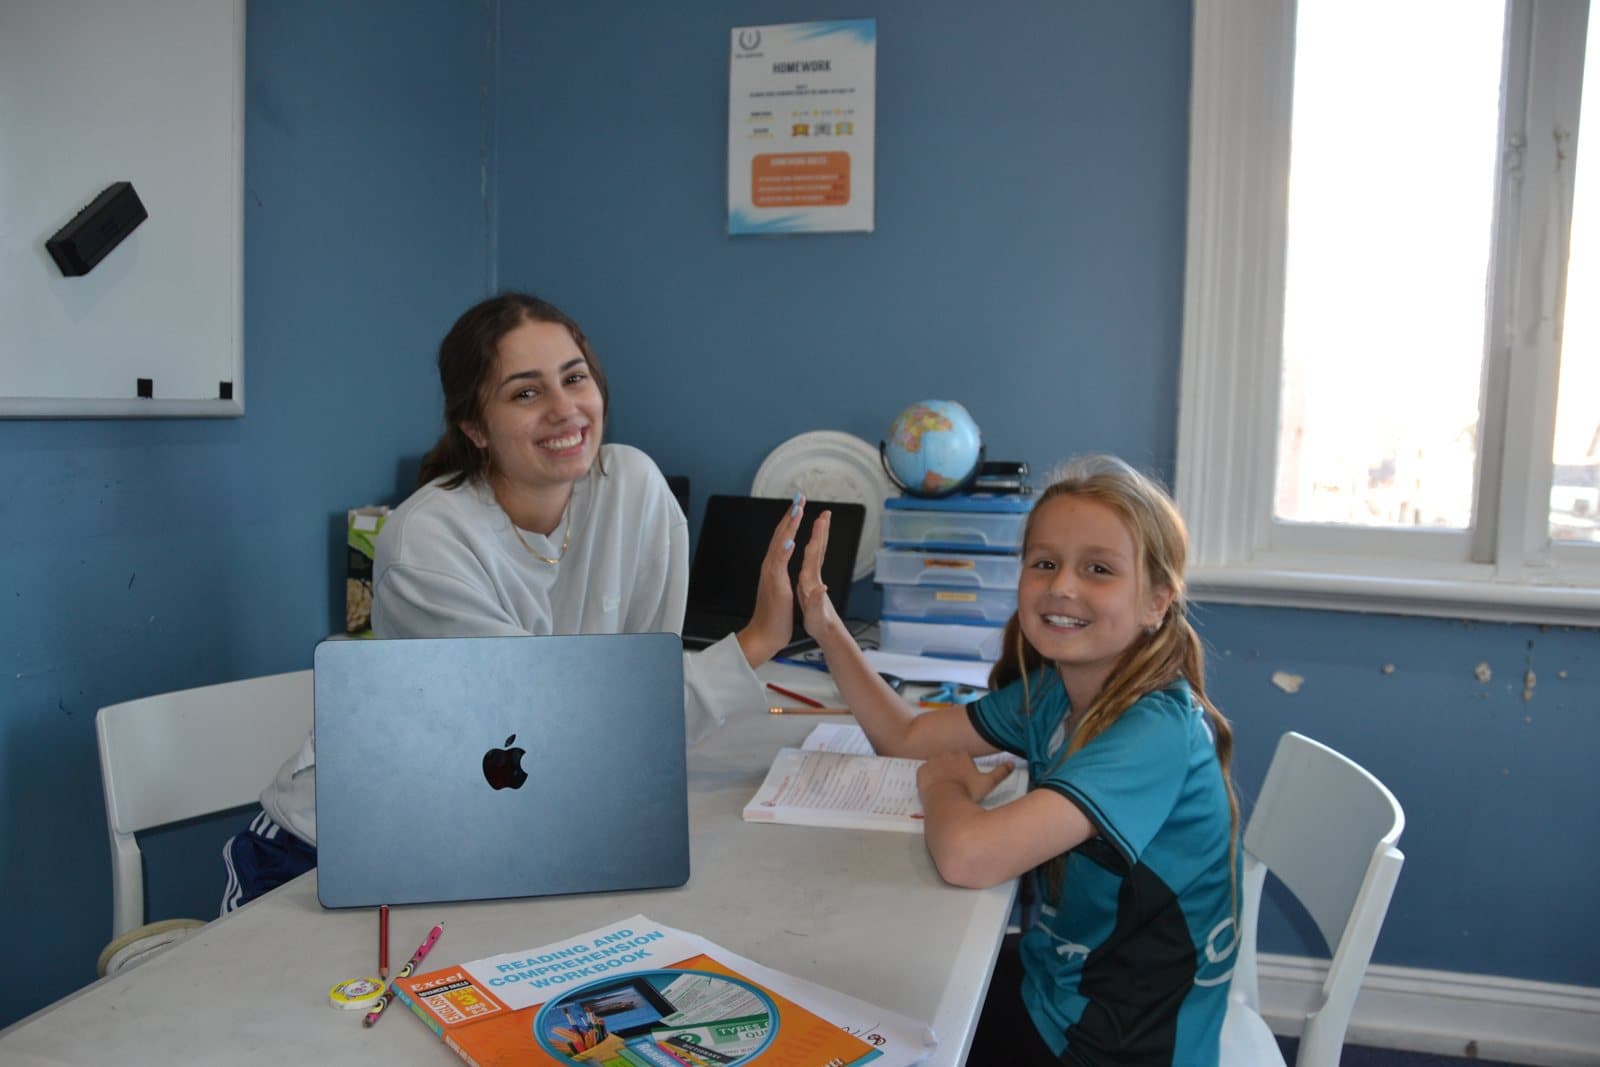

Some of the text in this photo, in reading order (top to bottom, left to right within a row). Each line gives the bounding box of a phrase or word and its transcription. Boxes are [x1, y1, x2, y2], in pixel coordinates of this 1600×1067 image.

[772, 60, 832, 73] HOMEWORK
[488, 930, 665, 987] COMPREHENSION
[495, 928, 634, 973] READING AND
[529, 948, 653, 989] WORKBOOK
[411, 972, 465, 991] Excel
[449, 980, 469, 990] SKILLS
[718, 1022, 760, 1035] TYPES
